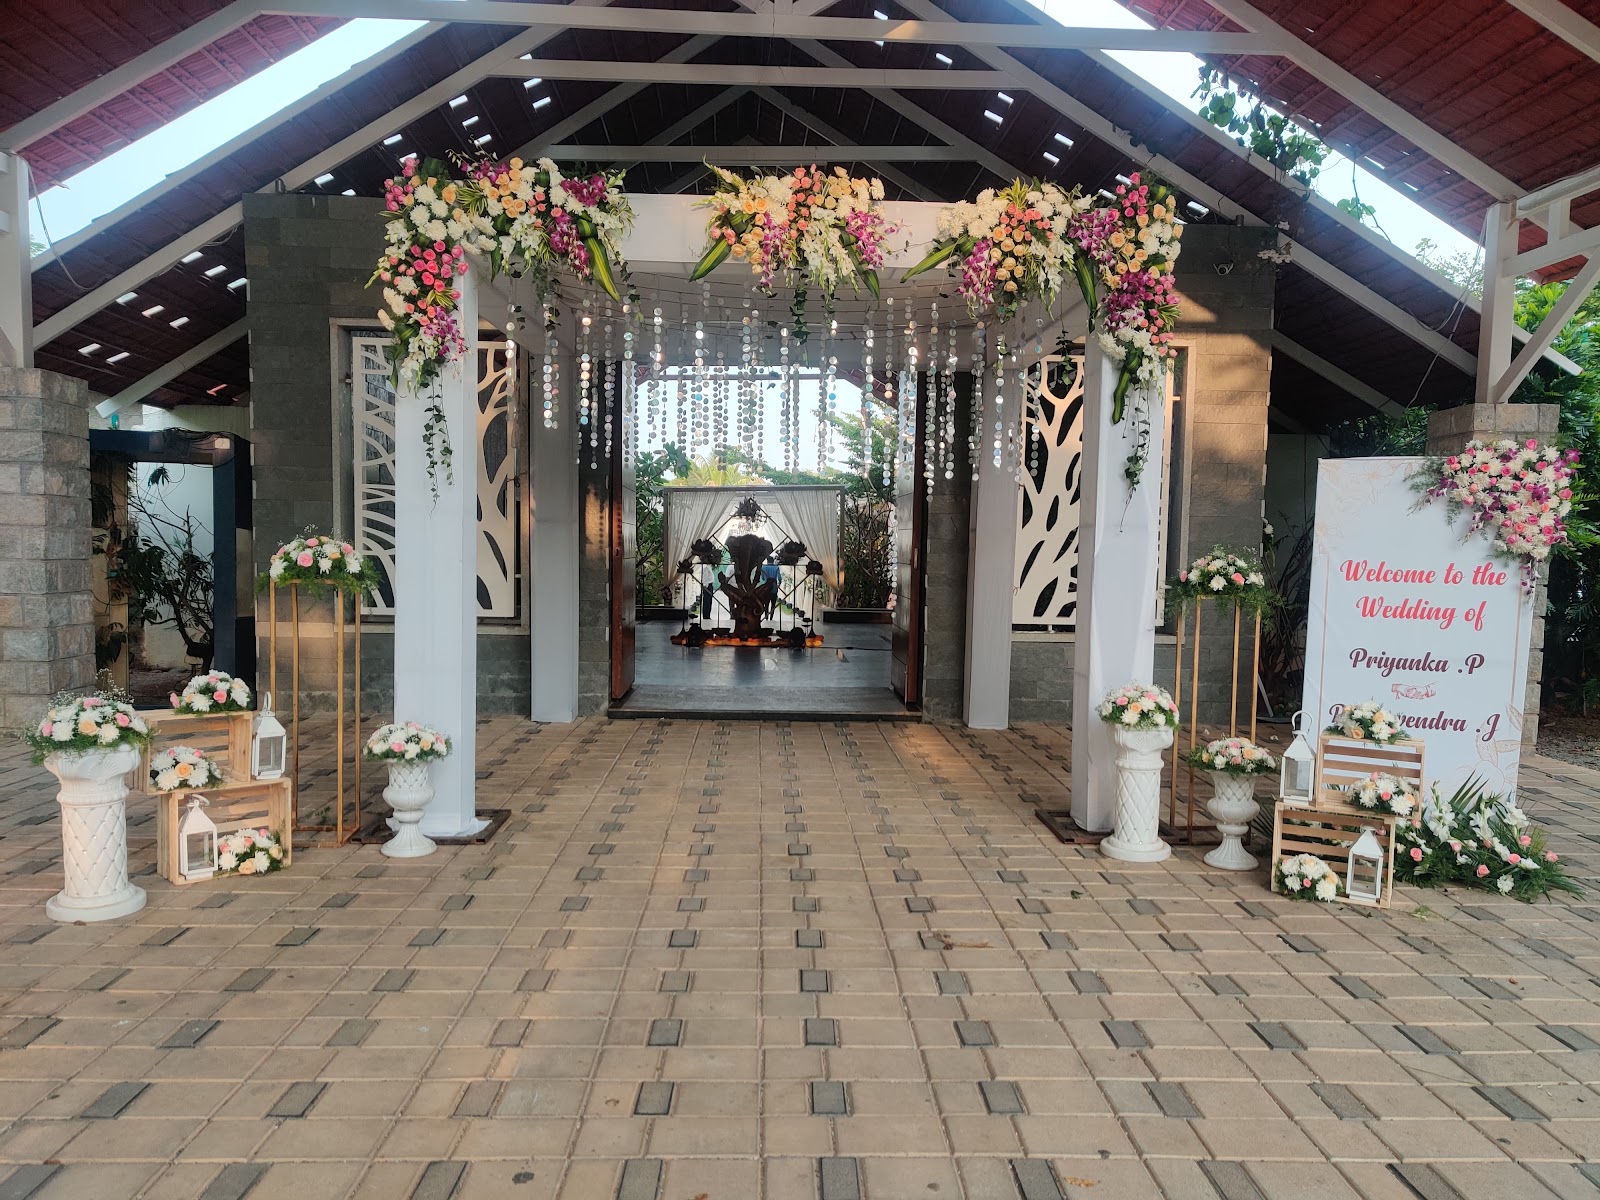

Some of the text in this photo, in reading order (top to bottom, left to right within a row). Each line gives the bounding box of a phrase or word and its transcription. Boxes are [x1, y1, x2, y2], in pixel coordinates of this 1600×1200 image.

[1339, 559, 1508, 586] Welcome to the
[1355, 596, 1487, 631] Wedding of
[1349, 647, 1485, 678] Priyanka .P
